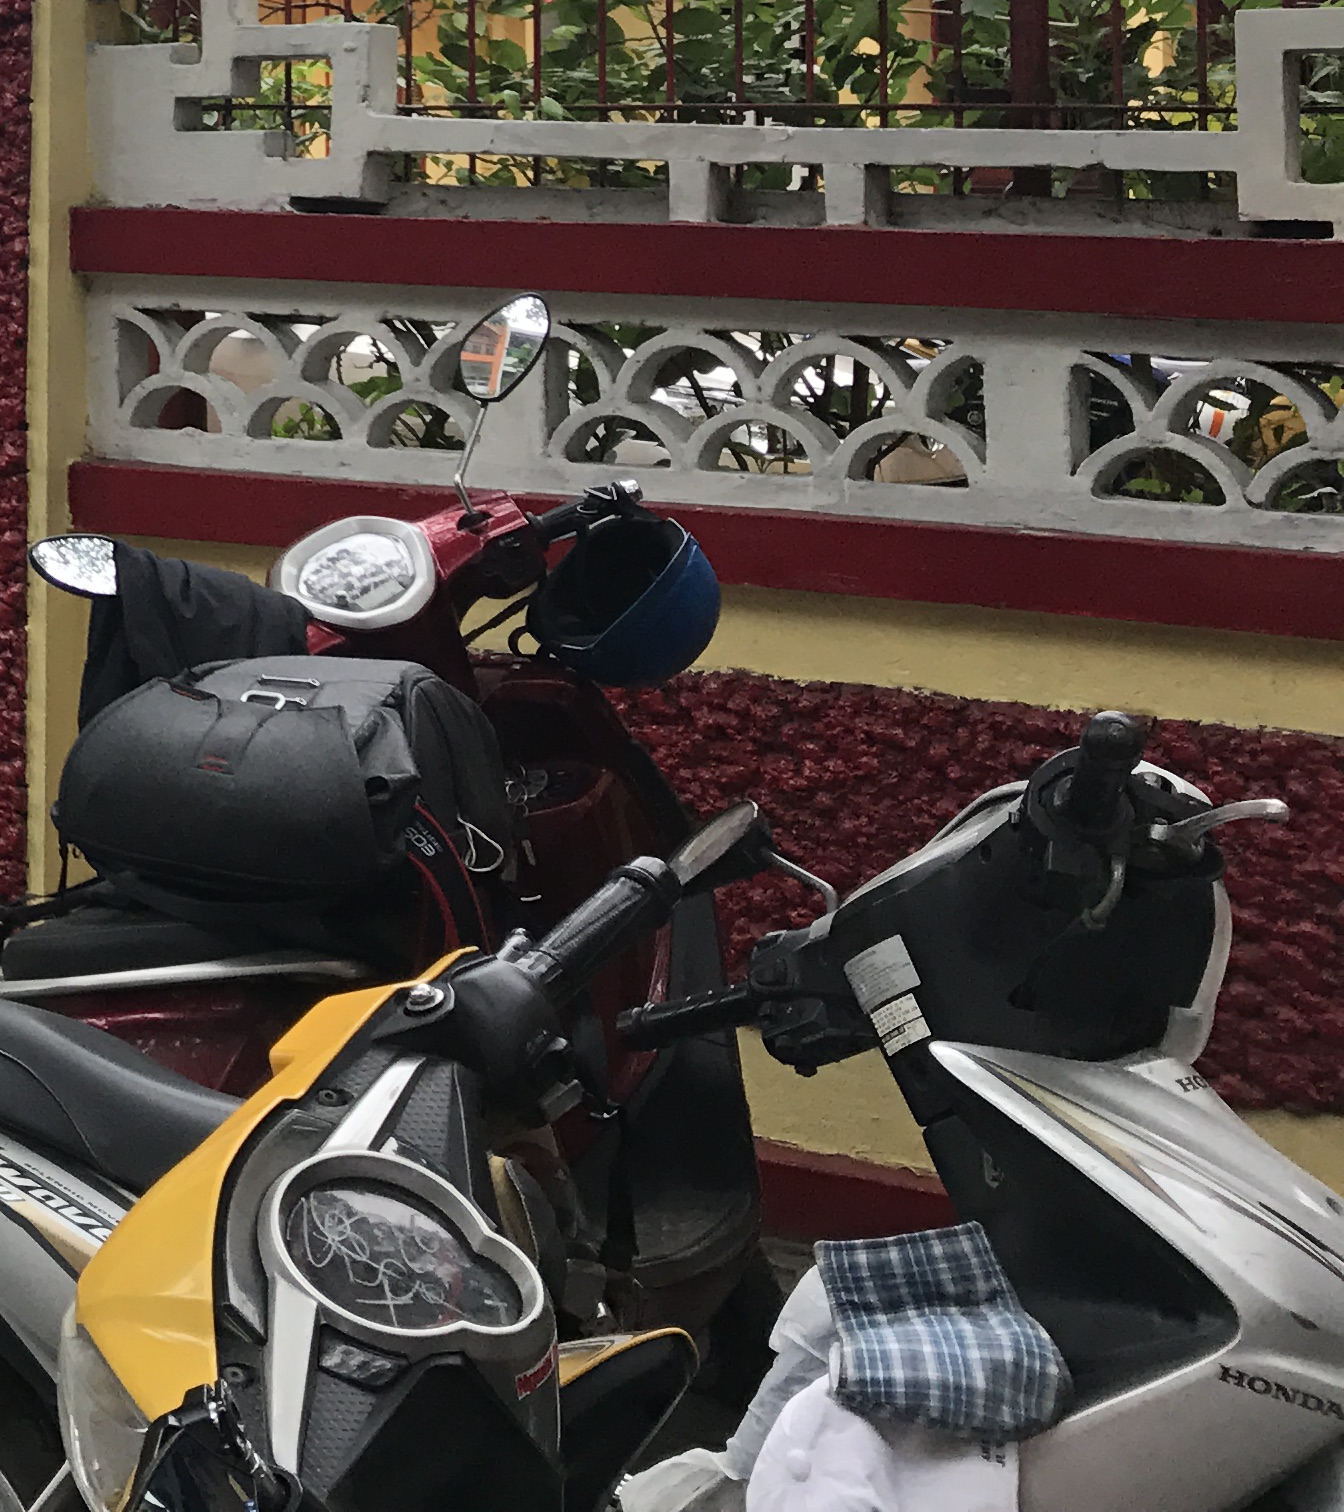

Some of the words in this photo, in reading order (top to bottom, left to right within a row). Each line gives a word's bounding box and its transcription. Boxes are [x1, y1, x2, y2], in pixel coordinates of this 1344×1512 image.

[405, 826, 436, 857] EOS
[1174, 1074, 1210, 1094] HO
[1218, 1363, 1344, 1421] HONDA
